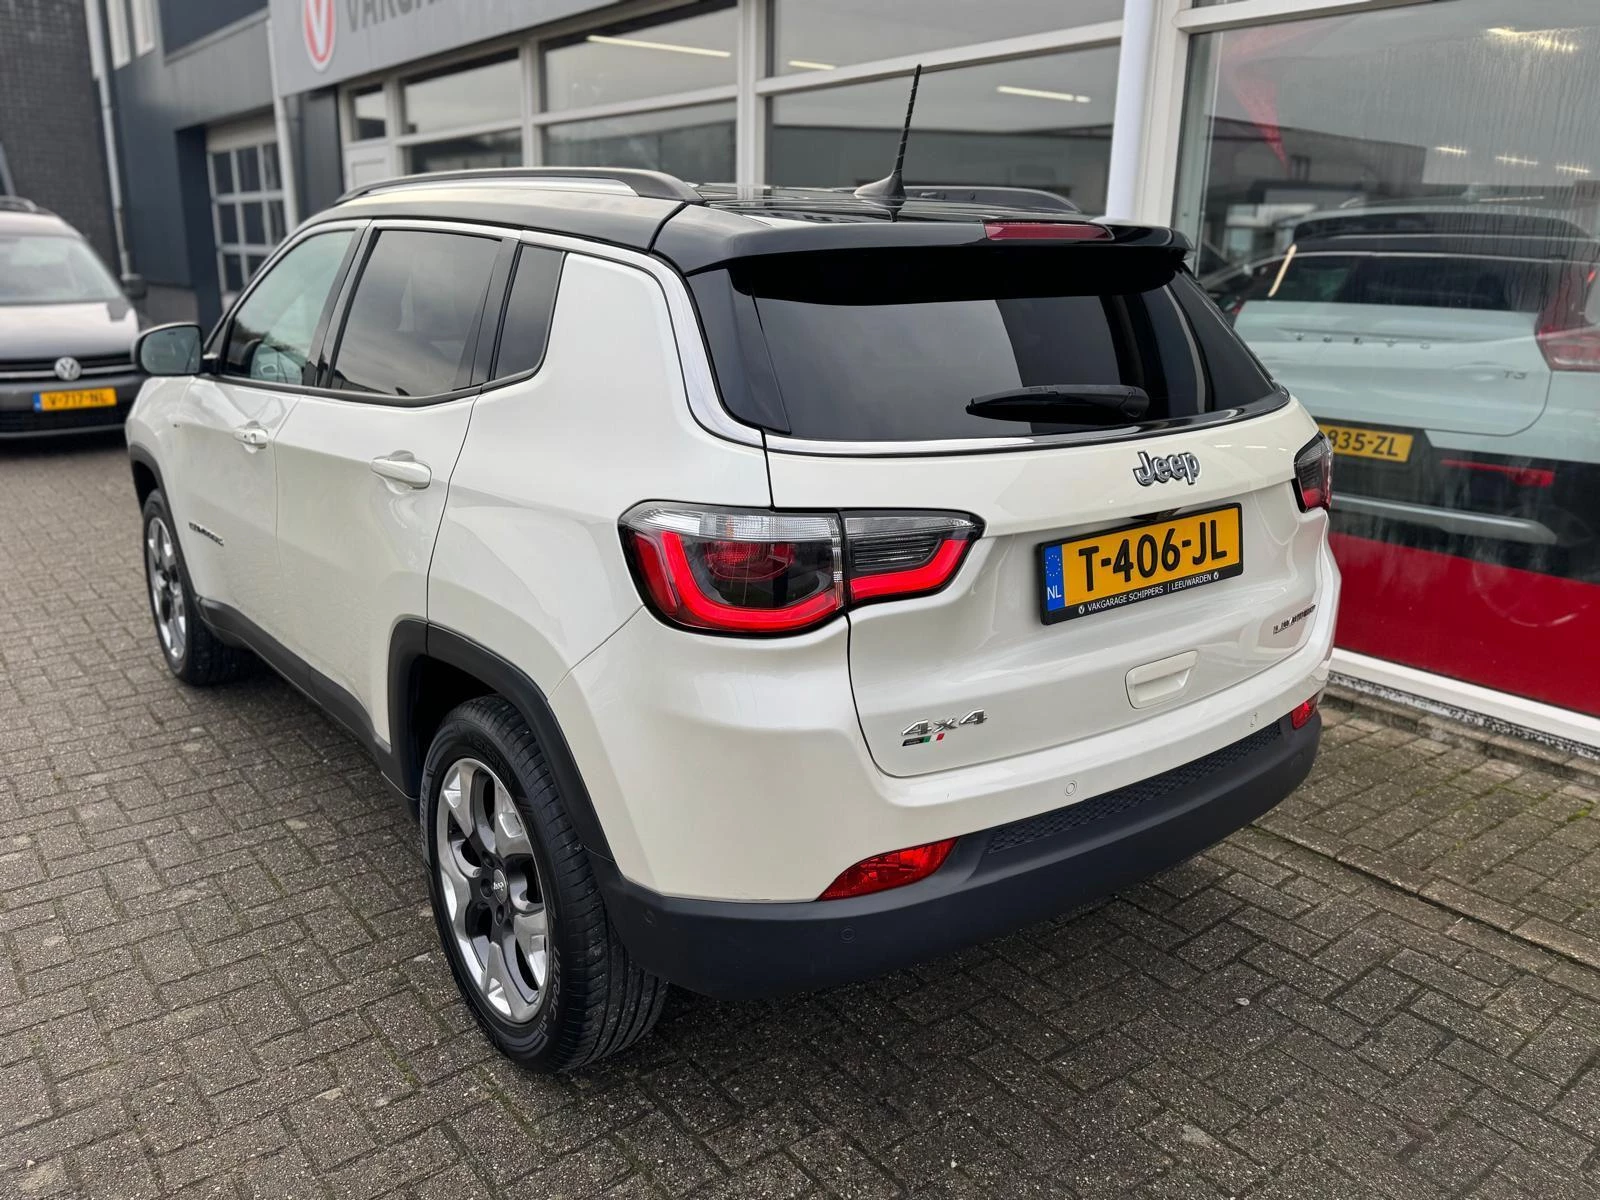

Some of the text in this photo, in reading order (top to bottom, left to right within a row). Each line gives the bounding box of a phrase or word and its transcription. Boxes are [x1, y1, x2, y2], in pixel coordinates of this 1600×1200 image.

[1133, 451, 1200, 486] Jeep
[1078, 519, 1228, 592] T-406-JL
[1047, 585, 1062, 601] NL
[1087, 593, 1128, 612] VAKGARAGE
[1129, 585, 1164, 601] SCHIPPERS
[1171, 574, 1212, 591] LEEUWARDEN
